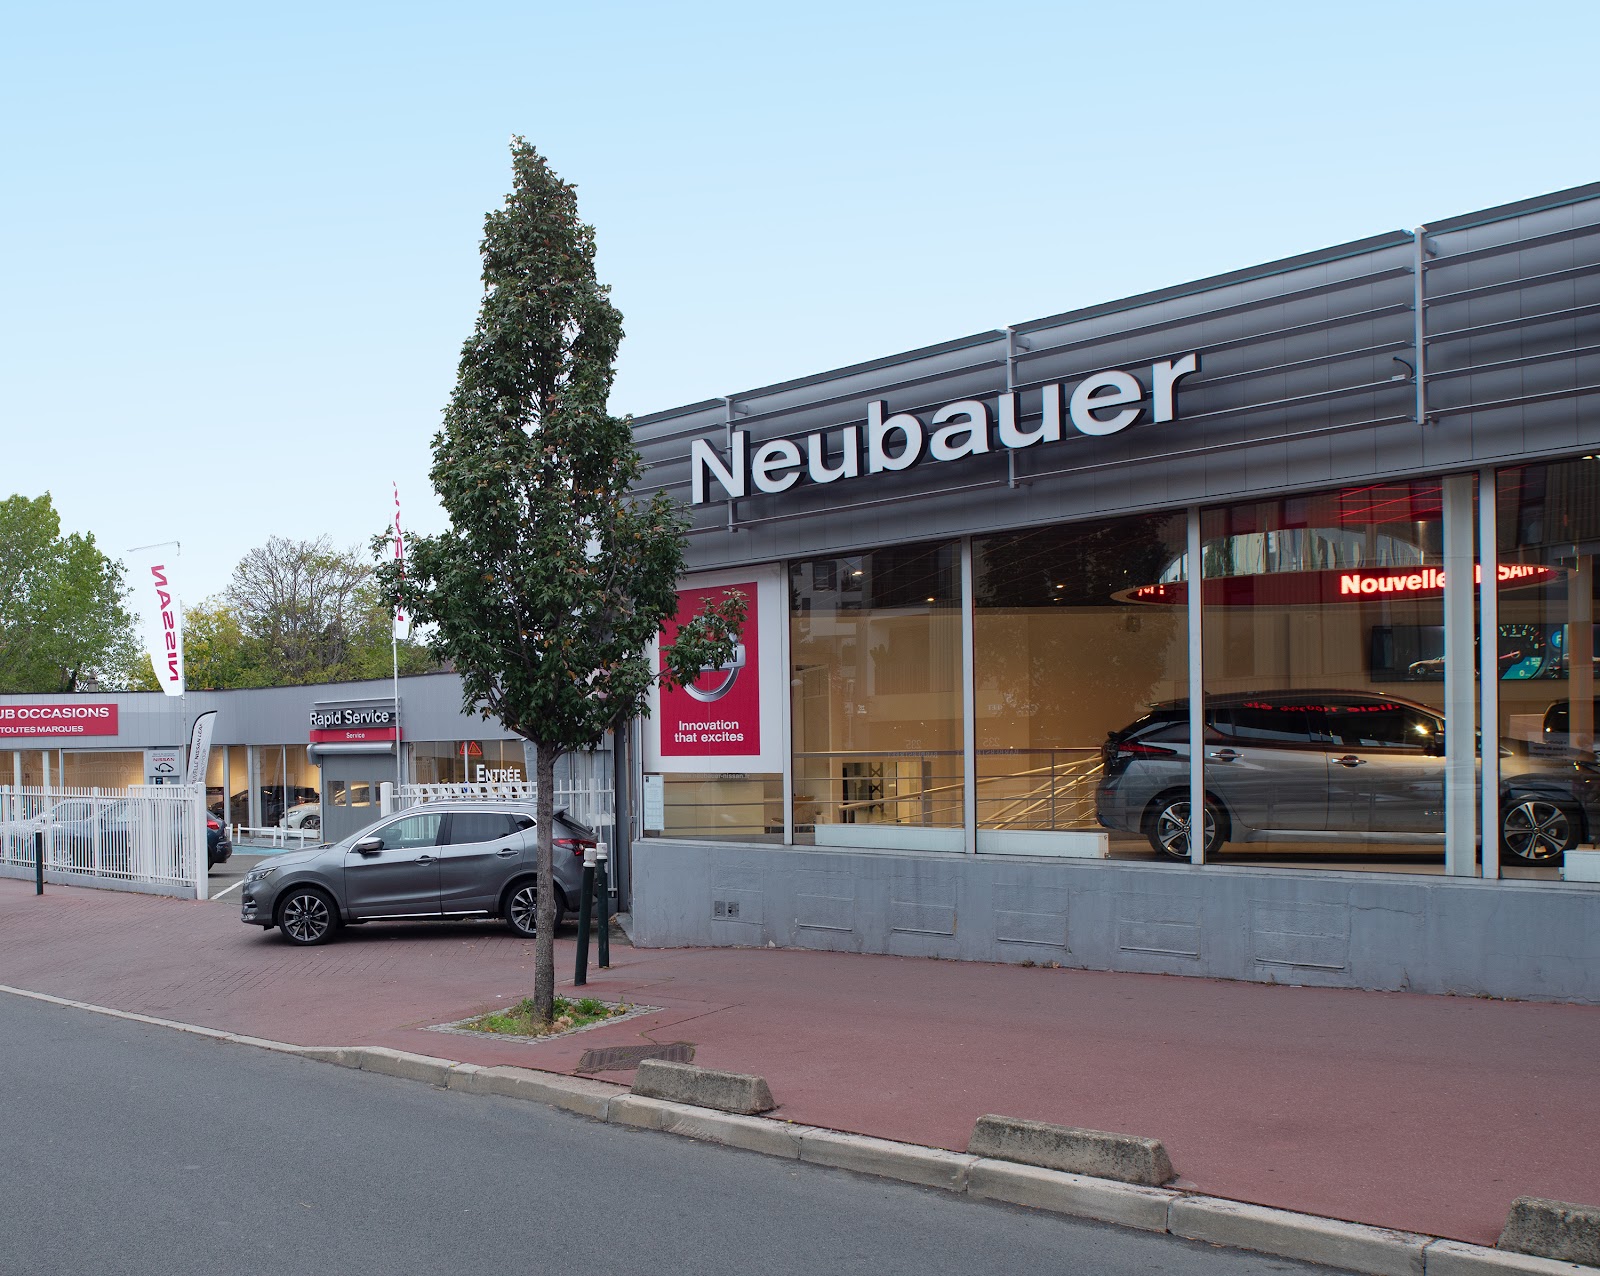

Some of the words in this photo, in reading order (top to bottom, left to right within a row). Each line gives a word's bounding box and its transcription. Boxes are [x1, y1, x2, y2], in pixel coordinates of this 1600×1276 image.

[691, 353, 1200, 504] Neubauer
[1340, 569, 1446, 595] Nouvelle
[17, 707, 110, 719] OCCASIONS
[309, 710, 342, 728] Rapid
[345, 709, 389, 725] Service
[0, 725, 36, 734] TOUTES
[37, 725, 84, 733] MARQUES
[679, 720, 739, 731] Innovation
[674, 732, 697, 743] that
[701, 732, 744, 742] excites
